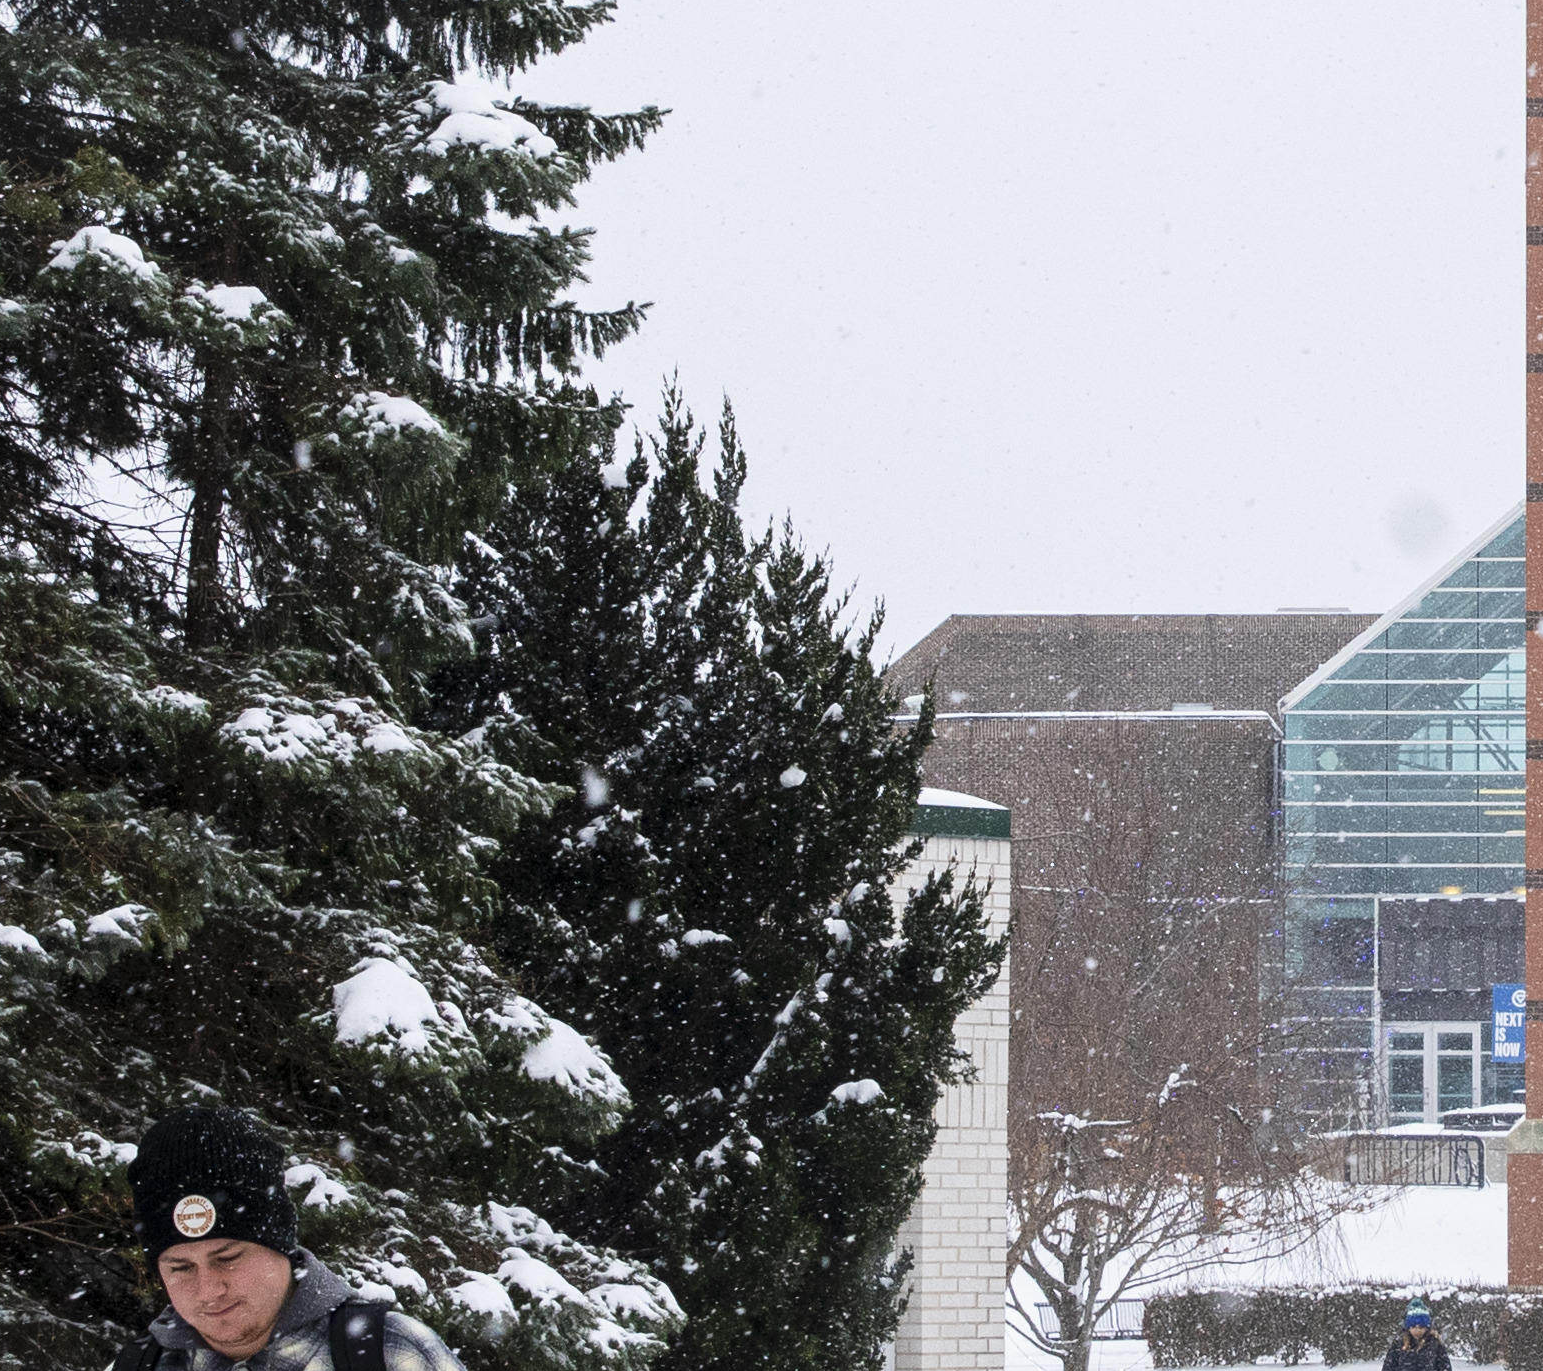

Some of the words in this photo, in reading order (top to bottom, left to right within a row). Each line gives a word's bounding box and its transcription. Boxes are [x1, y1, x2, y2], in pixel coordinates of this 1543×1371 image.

[1495, 1012, 1524, 1027] NEXT
[1495, 1027, 1506, 1042] IS
[1494, 1042, 1521, 1057] NOW
